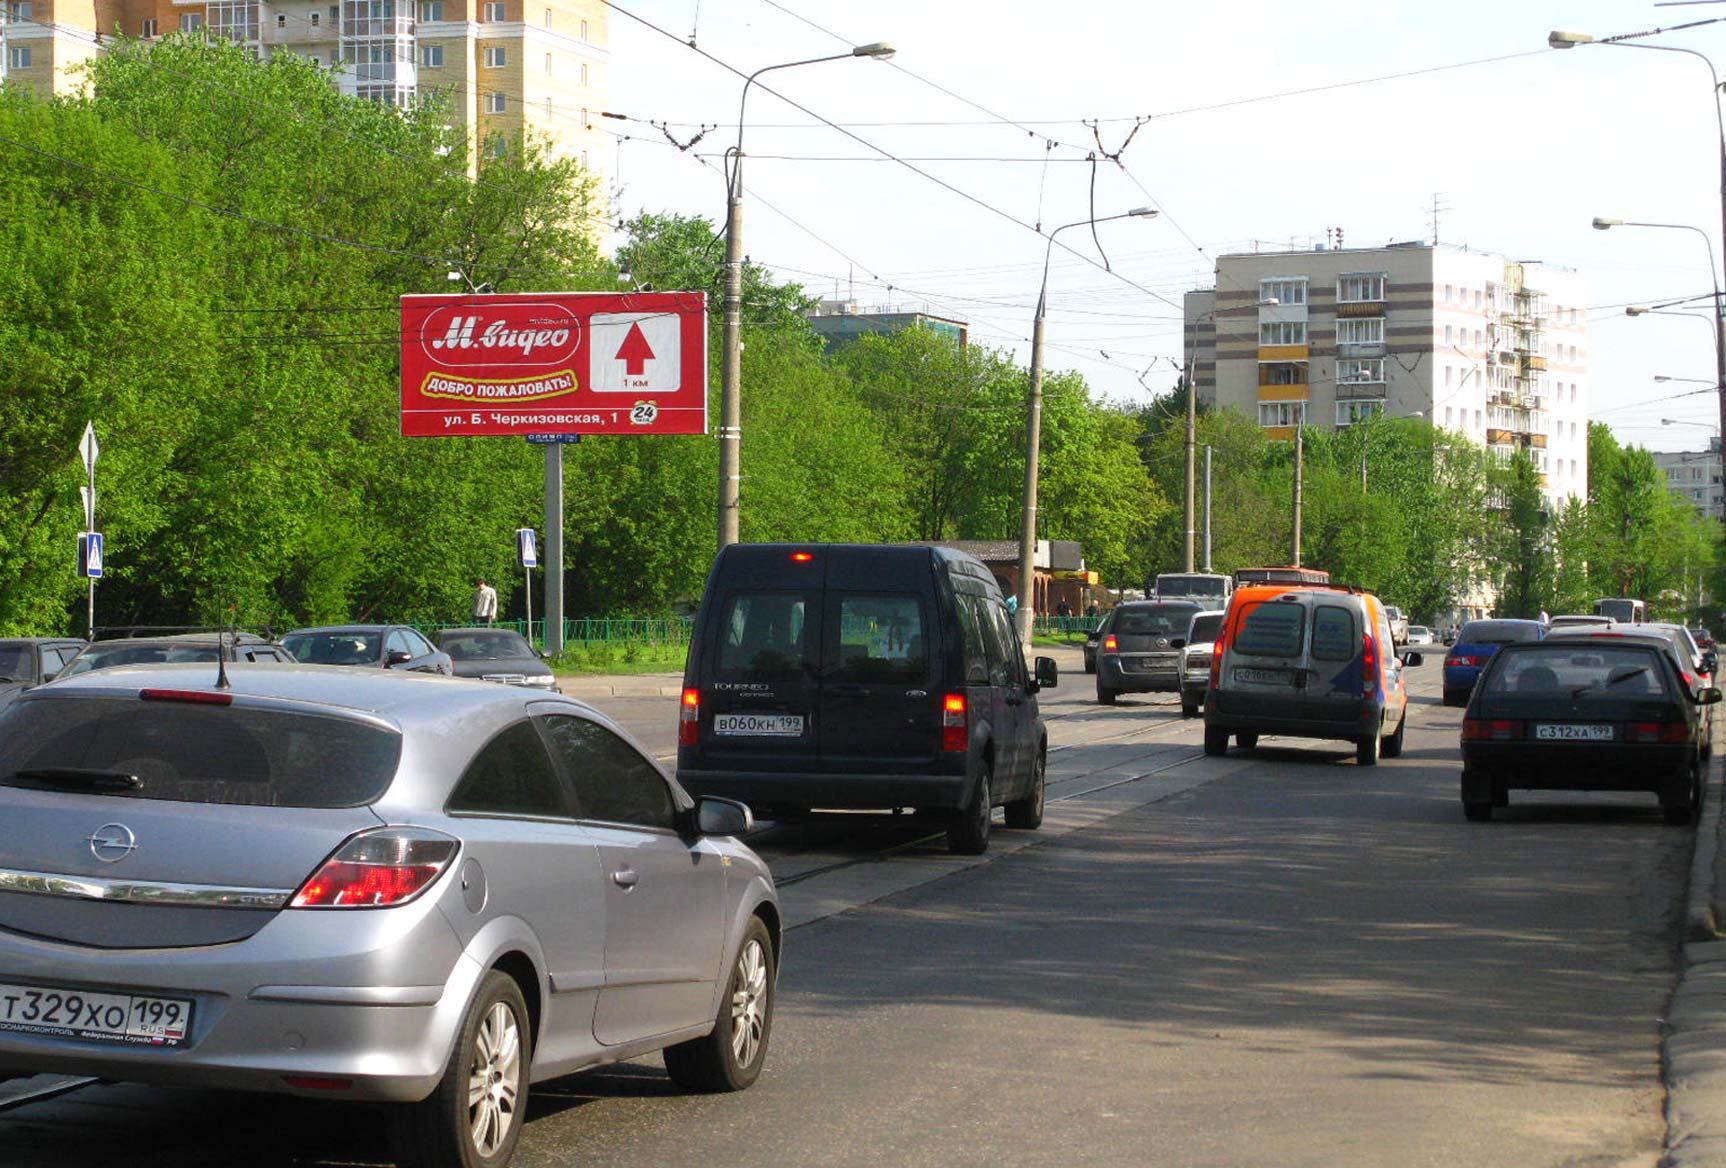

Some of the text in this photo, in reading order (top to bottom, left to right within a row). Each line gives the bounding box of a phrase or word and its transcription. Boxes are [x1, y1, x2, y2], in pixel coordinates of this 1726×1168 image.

[432, 316, 570, 356] М.видео
[427, 375, 572, 397] ДОБРО ПОЖАЛОВАТЬ!
[624, 379, 628, 388] 1
[634, 406, 654, 418] 24
[443, 412, 619, 427] ул. Б. Черкизовская, 1
[780, 717, 800, 728] 199
[4, 991, 181, 1029] Т329ХО 199
[0, 1023, 75, 1036] ОСНАРКОКОНТРОЛЬ
[140, 1024, 164, 1035] RUS
